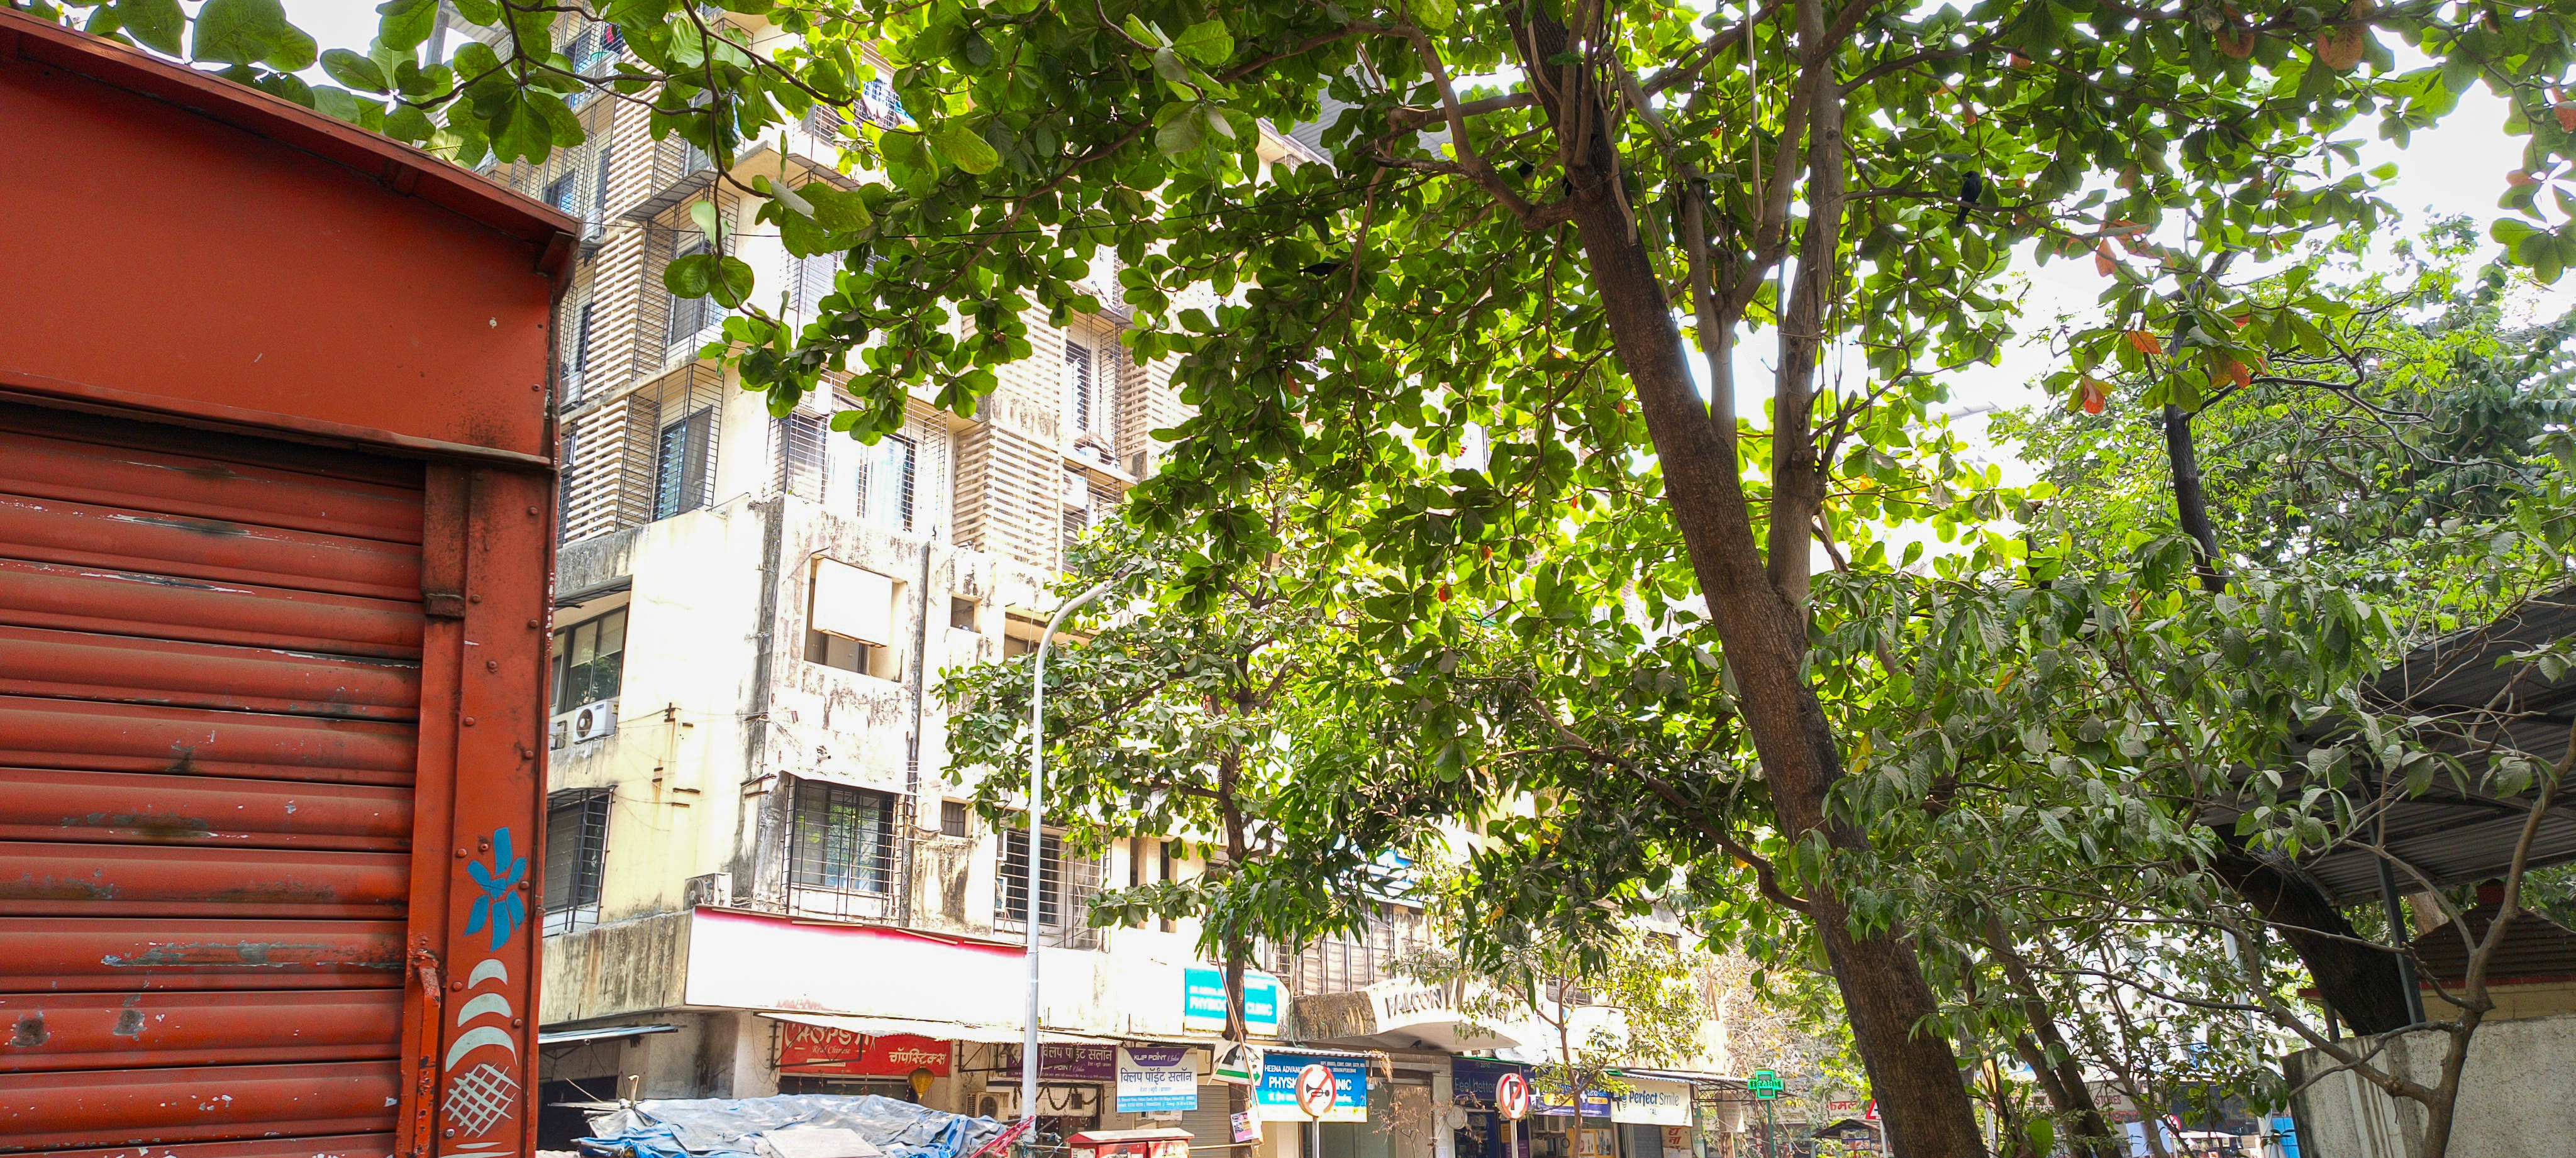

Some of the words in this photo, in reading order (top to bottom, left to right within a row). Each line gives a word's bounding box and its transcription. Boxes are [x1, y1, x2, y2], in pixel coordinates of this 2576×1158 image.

[1385, 988, 1442, 1018] FALCON
[1121, 1067, 1143, 1083] क्लिप
[1168, 1067, 1192, 1082] सलॉन
[1455, 1078, 1471, 1092] Feel
[1473, 1078, 1496, 1093] better
[1629, 1090, 1658, 1106] Perfect
[1659, 1091, 1679, 1106] Smile
[2095, 1095, 2121, 1105] STORES
